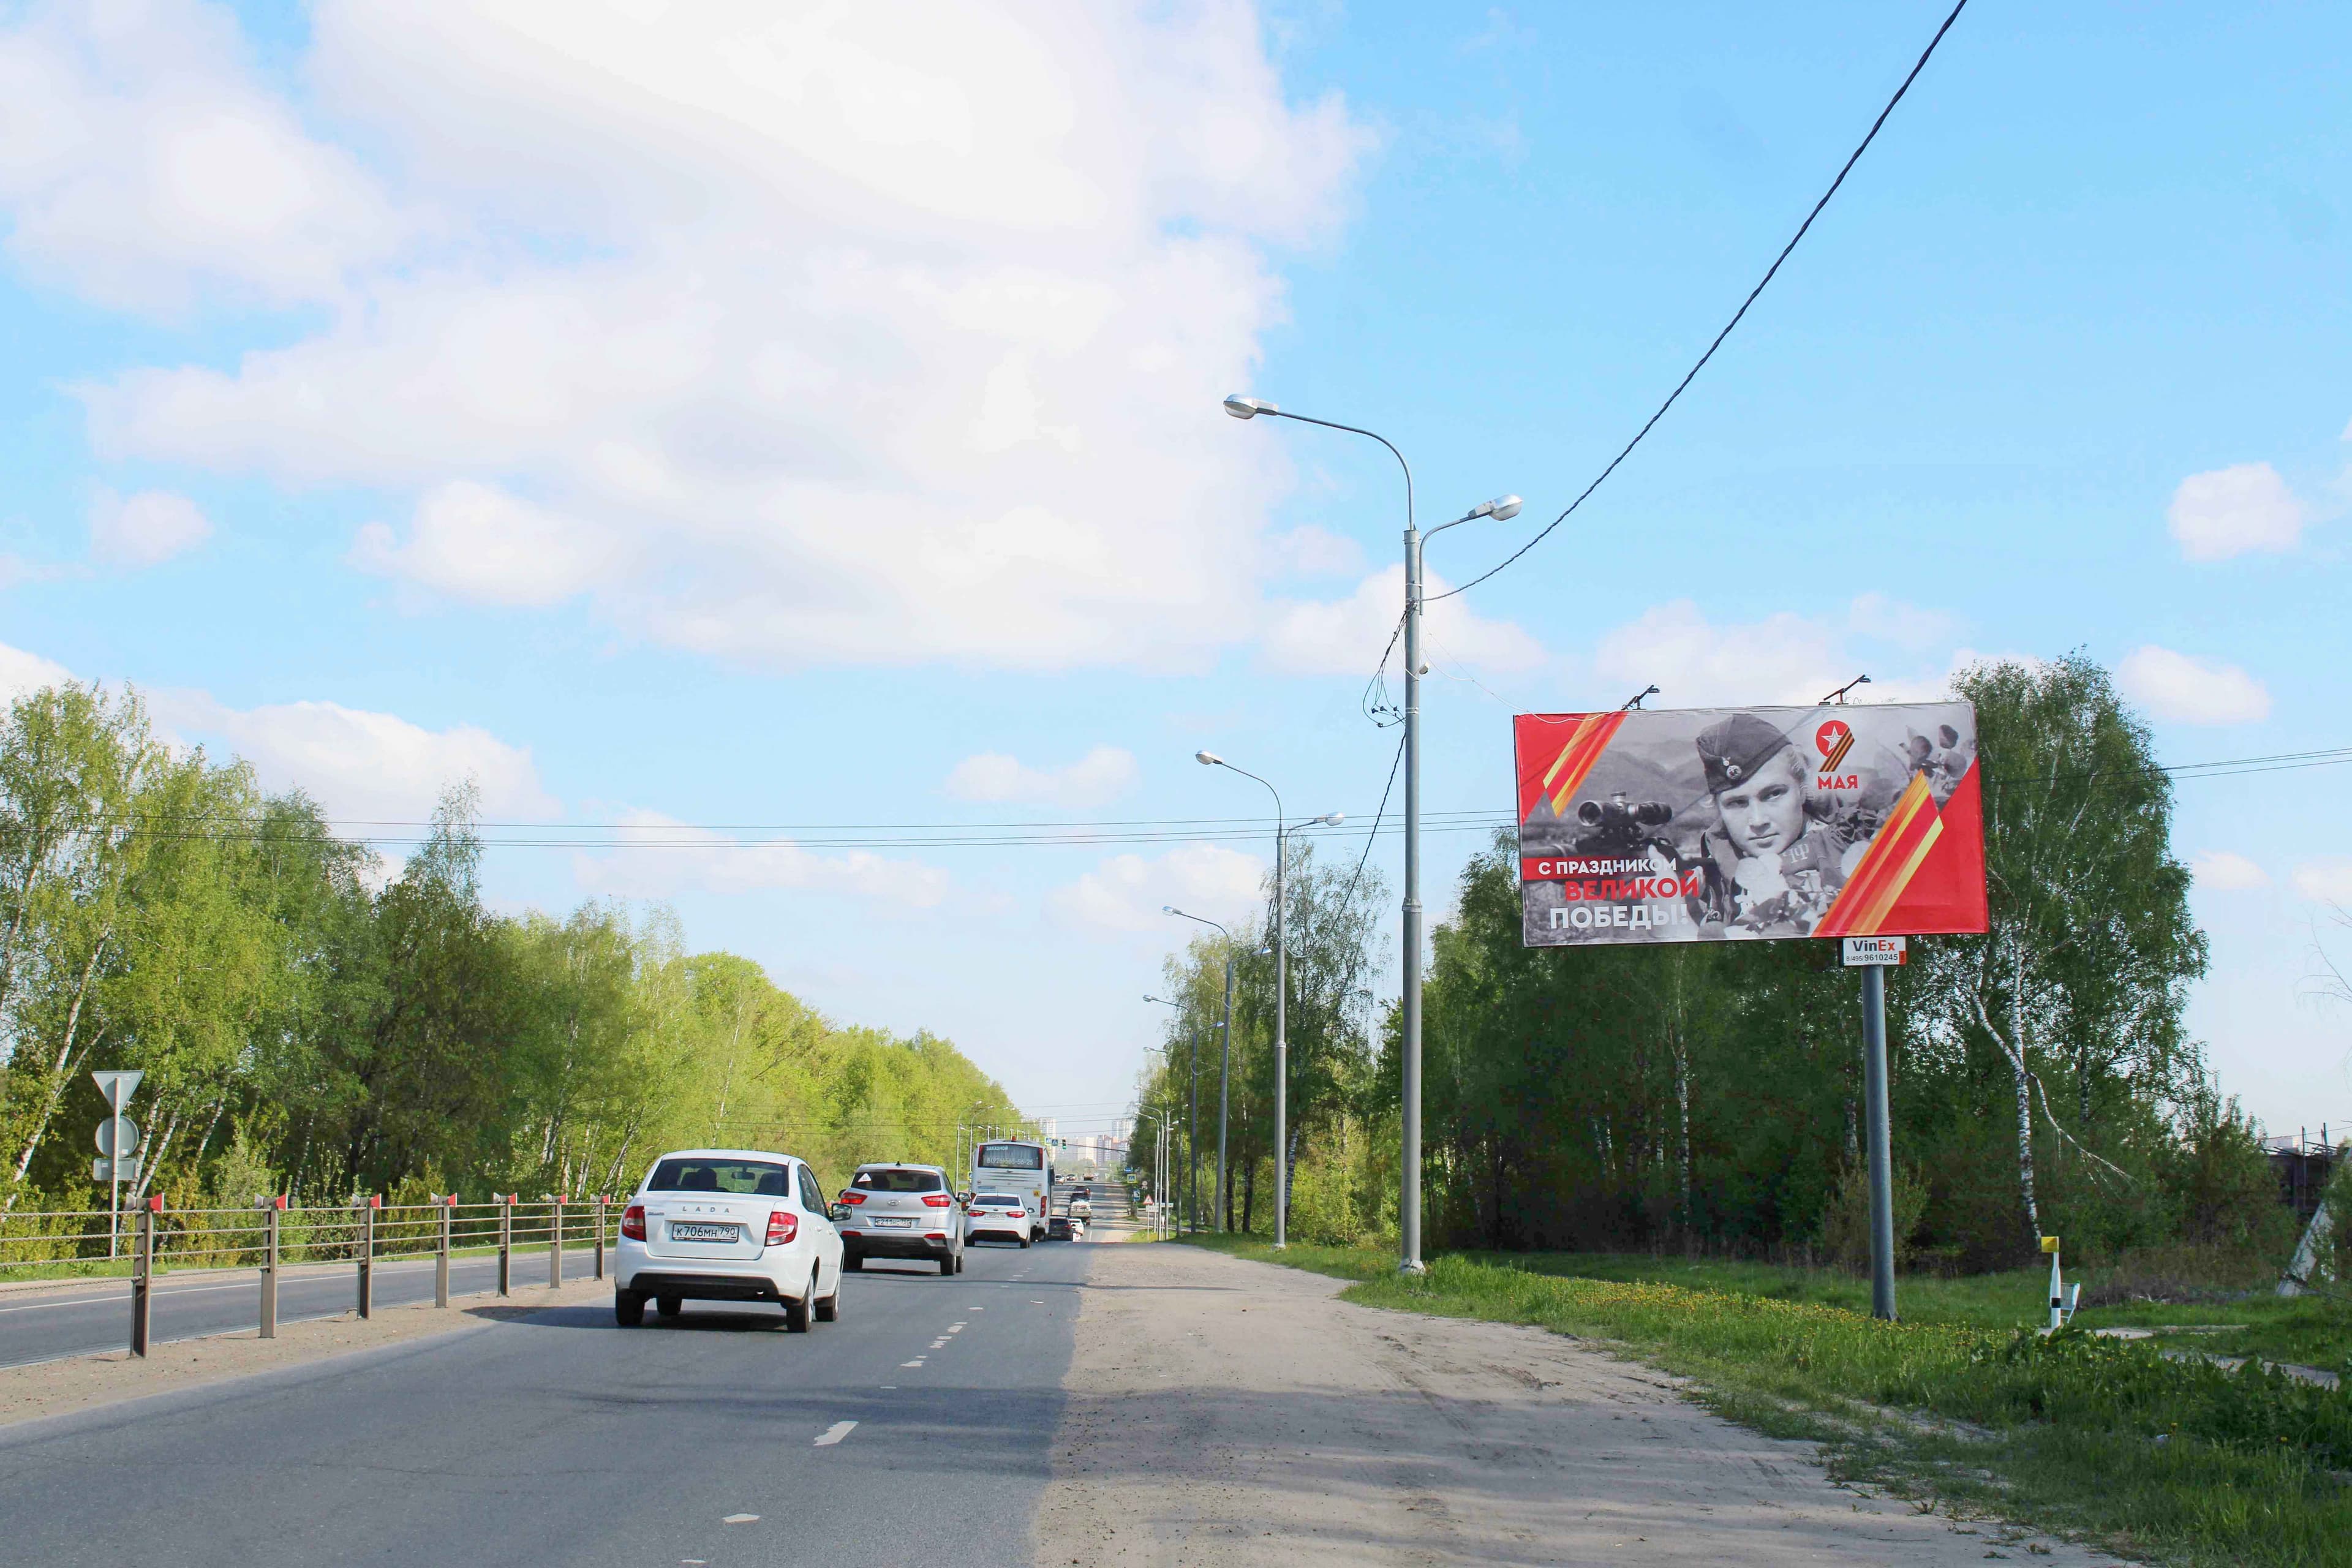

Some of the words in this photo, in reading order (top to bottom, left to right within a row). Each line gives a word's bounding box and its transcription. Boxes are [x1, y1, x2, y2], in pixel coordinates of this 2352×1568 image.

[1817, 775, 1858, 790] МАЯ
[1538, 862, 1551, 875] С
[1556, 858, 1676, 875] ПРАЗДНИКОМ
[1565, 870, 1700, 902] ВЕЛИКОЙ
[1550, 903, 1687, 931] ПОБЕДЫ!
[1852, 940, 1895, 951] VinEx
